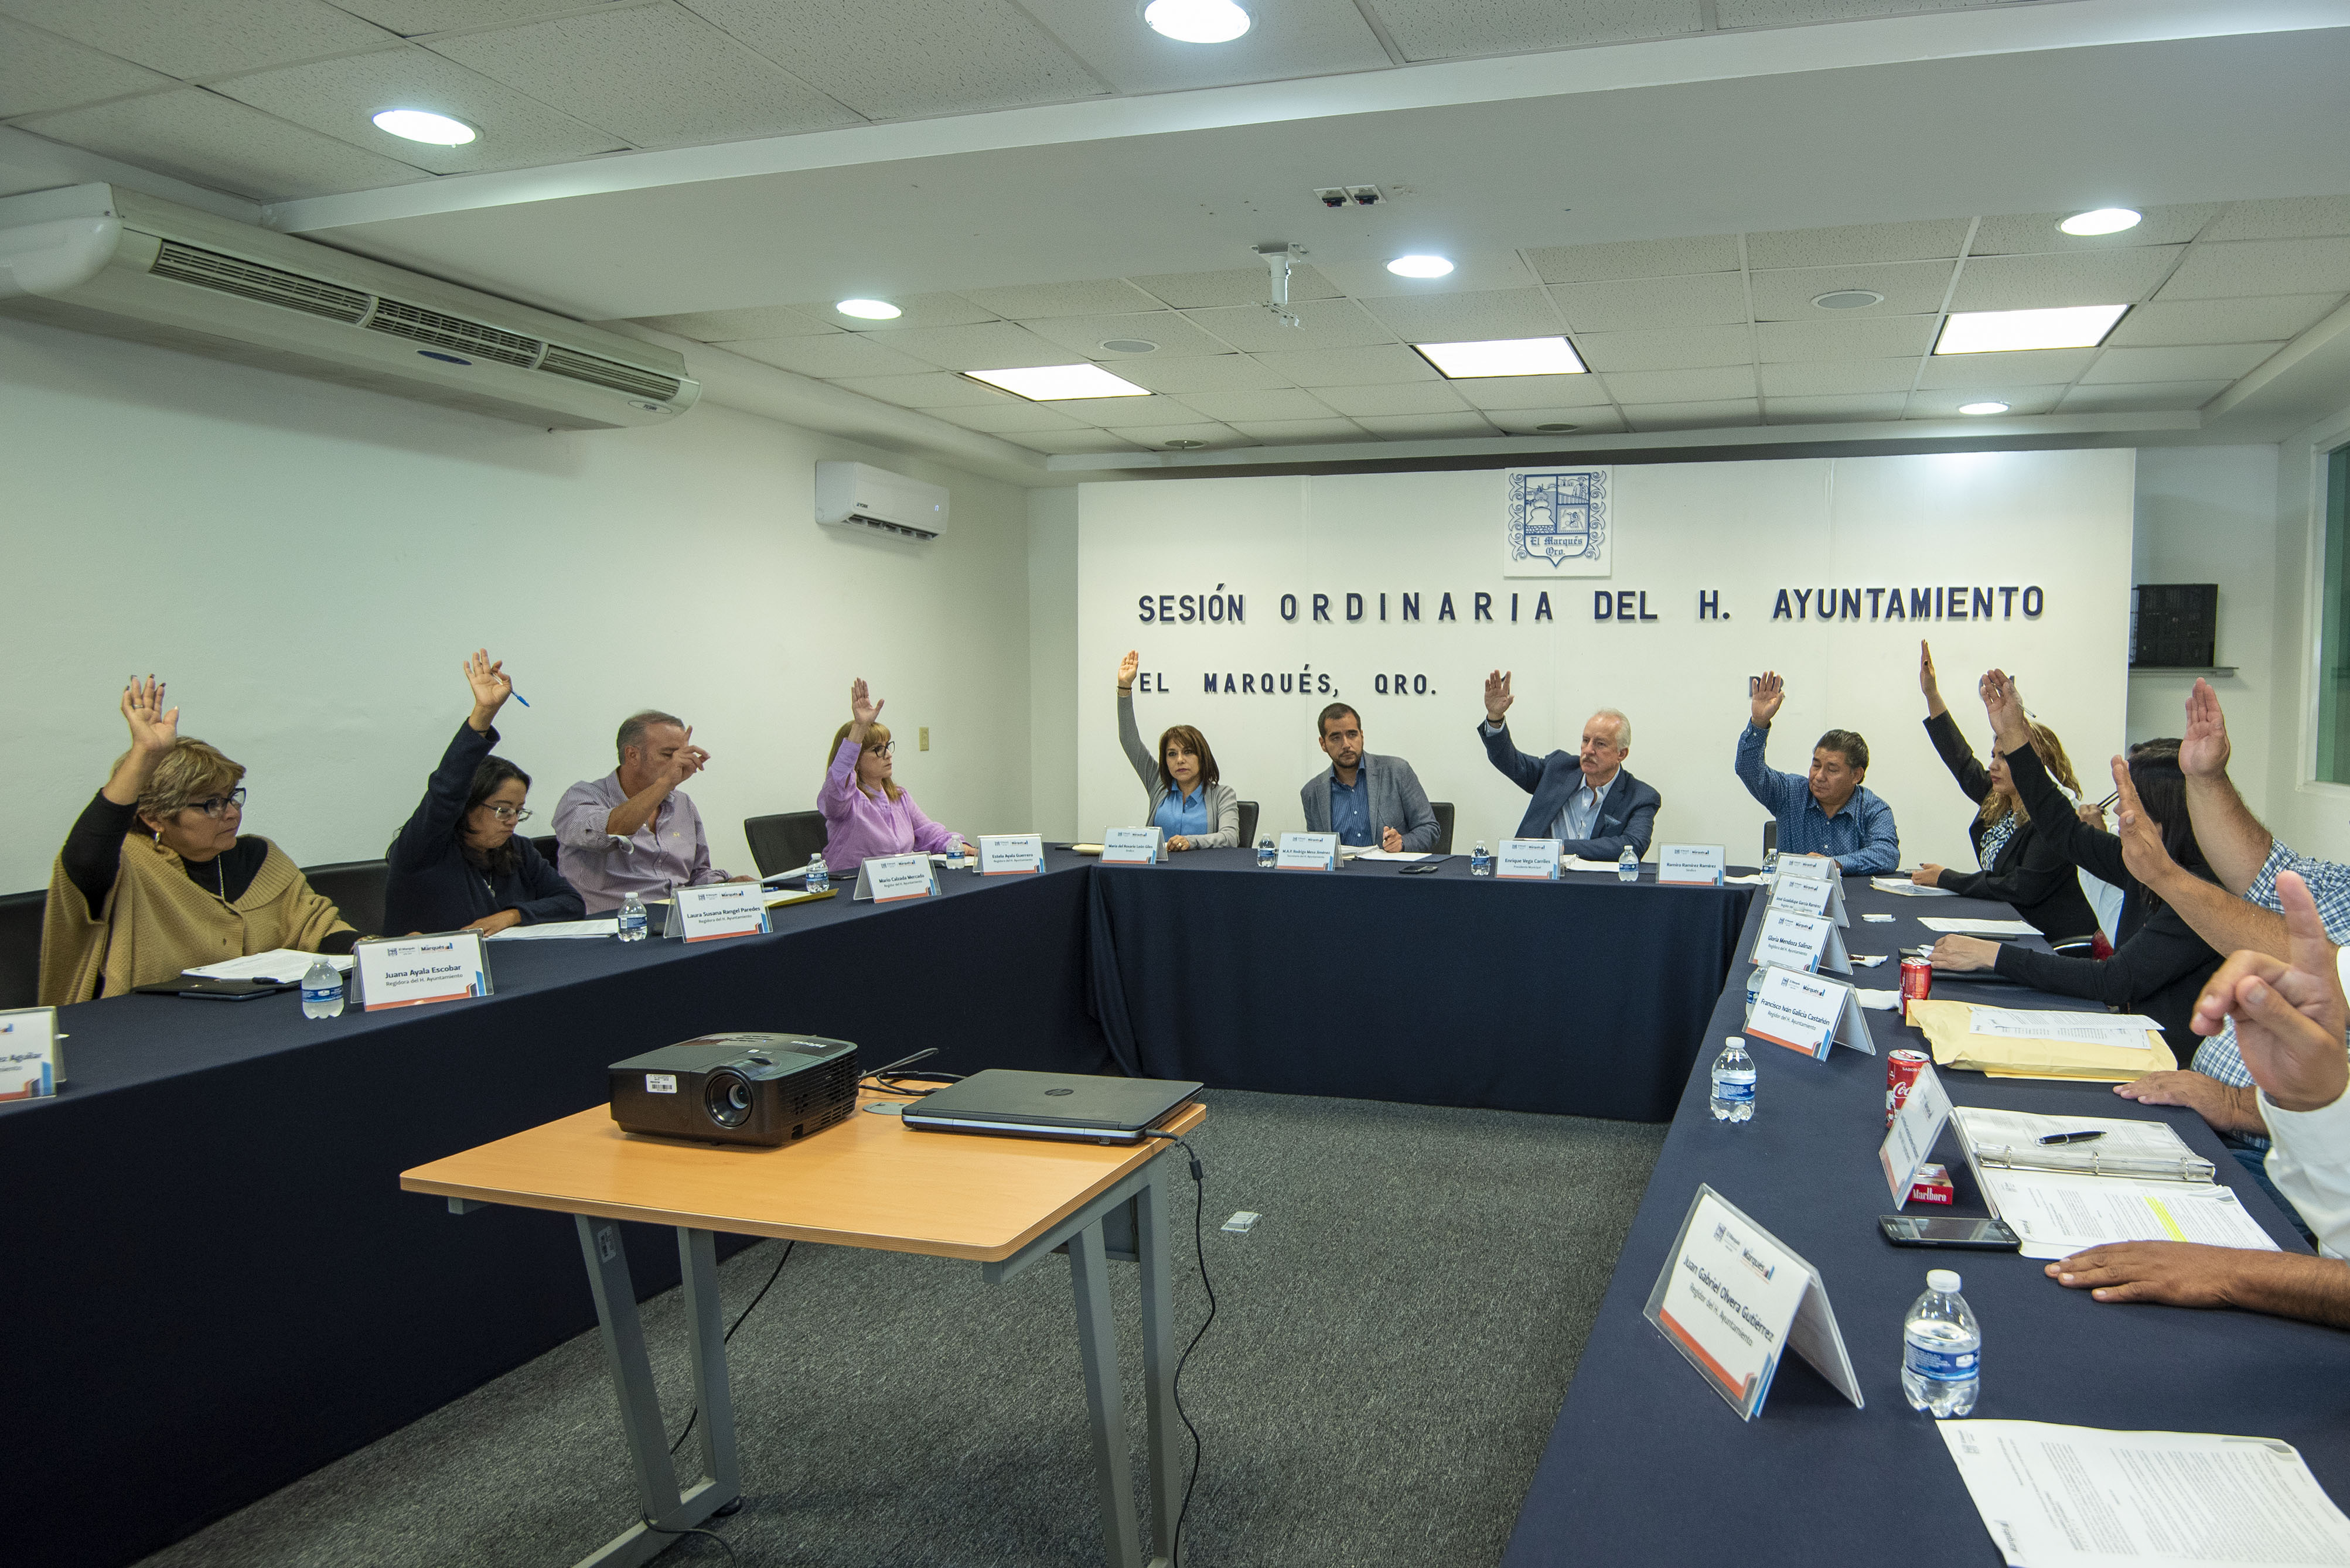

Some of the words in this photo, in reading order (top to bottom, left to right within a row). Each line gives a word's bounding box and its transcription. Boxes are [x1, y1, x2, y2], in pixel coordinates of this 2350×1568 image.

[1530, 537, 1540, 545] El
[1544, 535, 1582, 547] Marqués
[1138, 583, 1244, 622] SESIÓN
[1281, 591, 1554, 621] ORDINARIA
[1594, 590, 1658, 621] DEL
[1700, 589, 1731, 620] H.
[1773, 586, 2044, 620] AYUNTAMIENTO
[1140, 672, 1169, 692] EL
[1204, 664, 1338, 698] MARQUÉS,
[1374, 673, 1436, 695] QRO.
[1780, 938, 1797, 946] Mendoza
[1798, 941, 1813, 949] Salinas
[410, 968, 429, 977] Ayala
[432, 965, 461, 973] Escobar
[427, 973, 463, 982] Ayuntamiento
[1761, 999, 1781, 1010] Francisco
[1782, 1005, 1792, 1013] Iván
[1792, 1009, 1807, 1018] Galicia
[1808, 1013, 1830, 1026] Castañón
[1768, 1010, 1781, 1019] Regidor
[1791, 1019, 1816, 1030] Ayuntamiento
[1912, 1187, 1947, 1202] Marlboro
[1742, 1248, 1765, 1272] Marqués
[1683, 1255, 1698, 1274] Juan
[1698, 1267, 1721, 1294] Gabriel
[1720, 1287, 1741, 1313] Olvera
[1742, 1306, 1774, 1342] Gutiérrez
[1690, 1282, 1706, 1303] Regidor
[1706, 1297, 1714, 1310] del
[1719, 1310, 1753, 1346] Ayuntamiento
